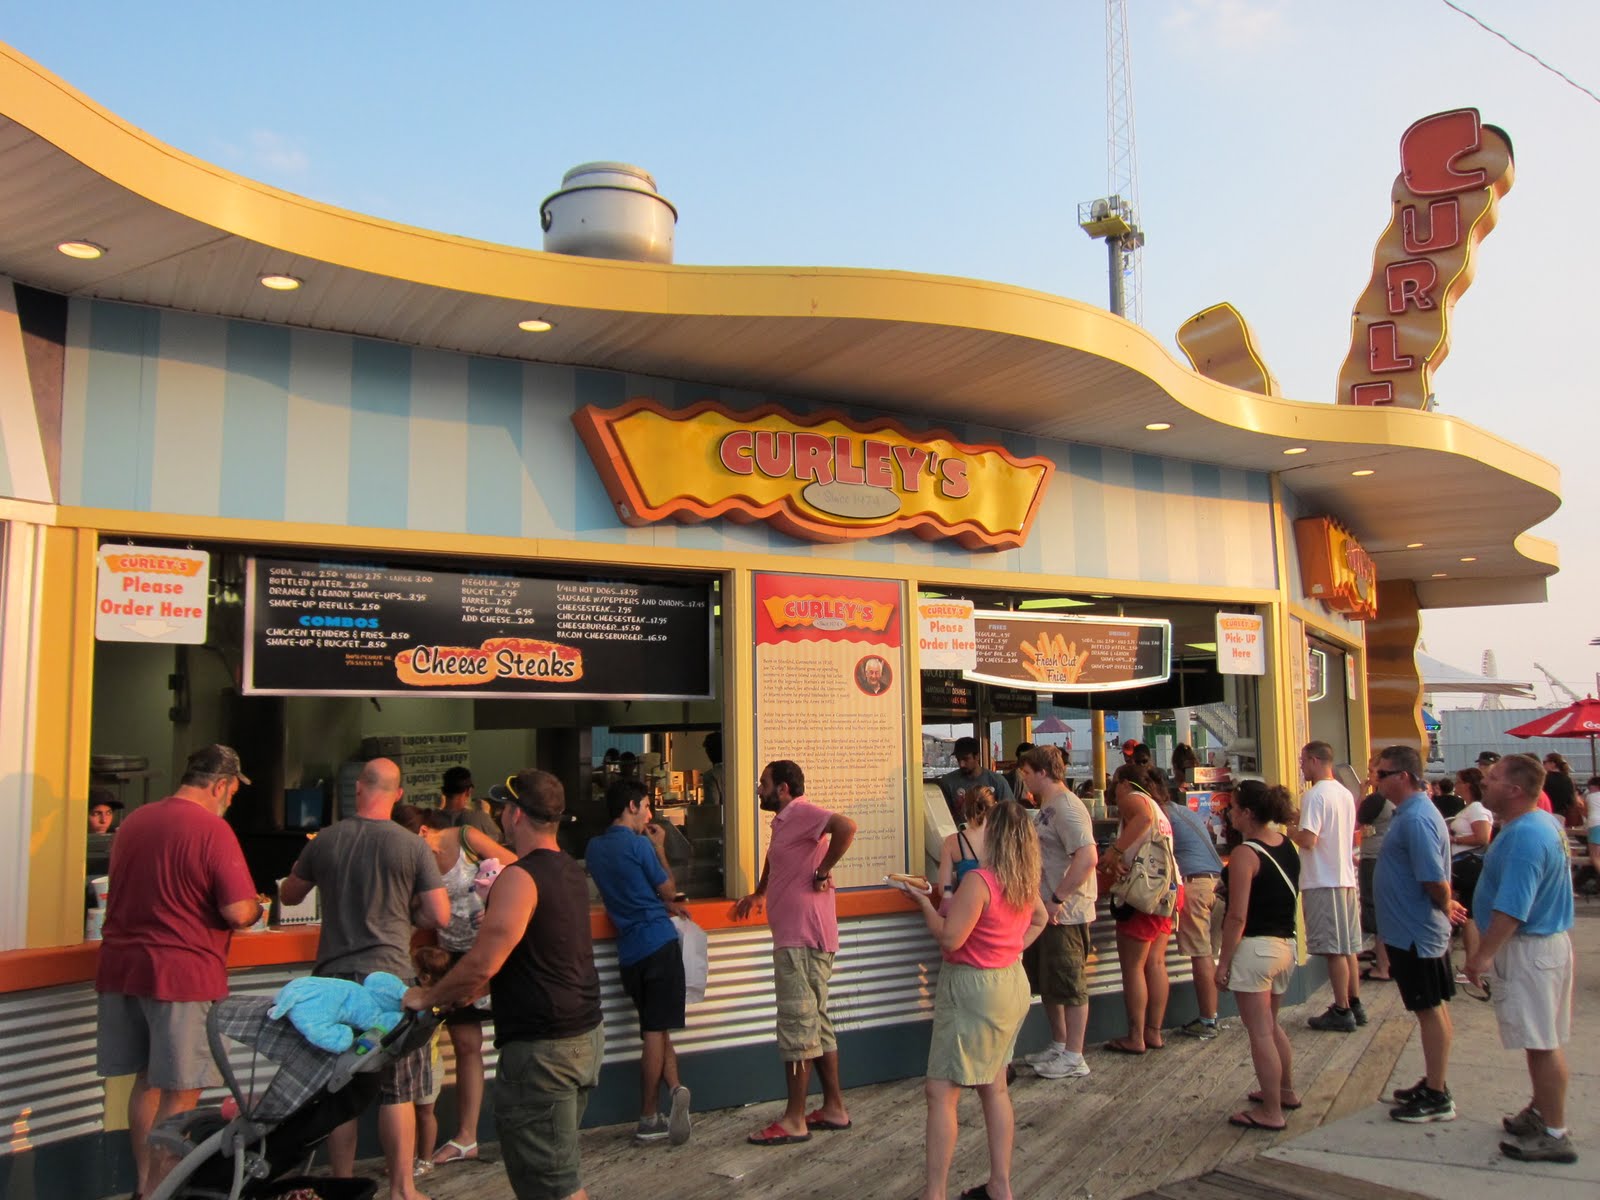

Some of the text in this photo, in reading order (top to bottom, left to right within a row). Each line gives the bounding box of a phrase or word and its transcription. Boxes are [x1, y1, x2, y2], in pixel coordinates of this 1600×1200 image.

[720, 430, 970, 499] CURLEY'S
[120, 558, 188, 571] CURLEY'S
[122, 576, 184, 594] Please
[269, 577, 310, 586] BOTTLED
[269, 587, 307, 596] ORANGE
[317, 589, 350, 598] LEMON
[579, 586, 594, 594] HOT
[269, 599, 317, 608] SHAKE-UP
[556, 594, 592, 603] SAUSAGE
[641, 598, 657, 606] AND
[100, 599, 203, 618] Order Here
[784, 601, 874, 621] CURLEY'S
[928, 607, 964, 615] CURLEY'S
[299, 615, 379, 629] COMBOS
[461, 614, 478, 622] ADD
[556, 612, 592, 621] CHICKEN
[930, 620, 964, 632] Please
[266, 628, 307, 637] CHICKEN
[309, 629, 350, 638] TENDERS
[556, 631, 583, 639] BACON
[266, 638, 314, 647] SHAKE-UP
[920, 637, 975, 650] Order Here
[1232, 648, 1251, 658] Here
[411, 645, 576, 677] Cheese Steaks
[1035, 653, 1077, 667] Fresh Cut
[1047, 669, 1067, 682] Fries
